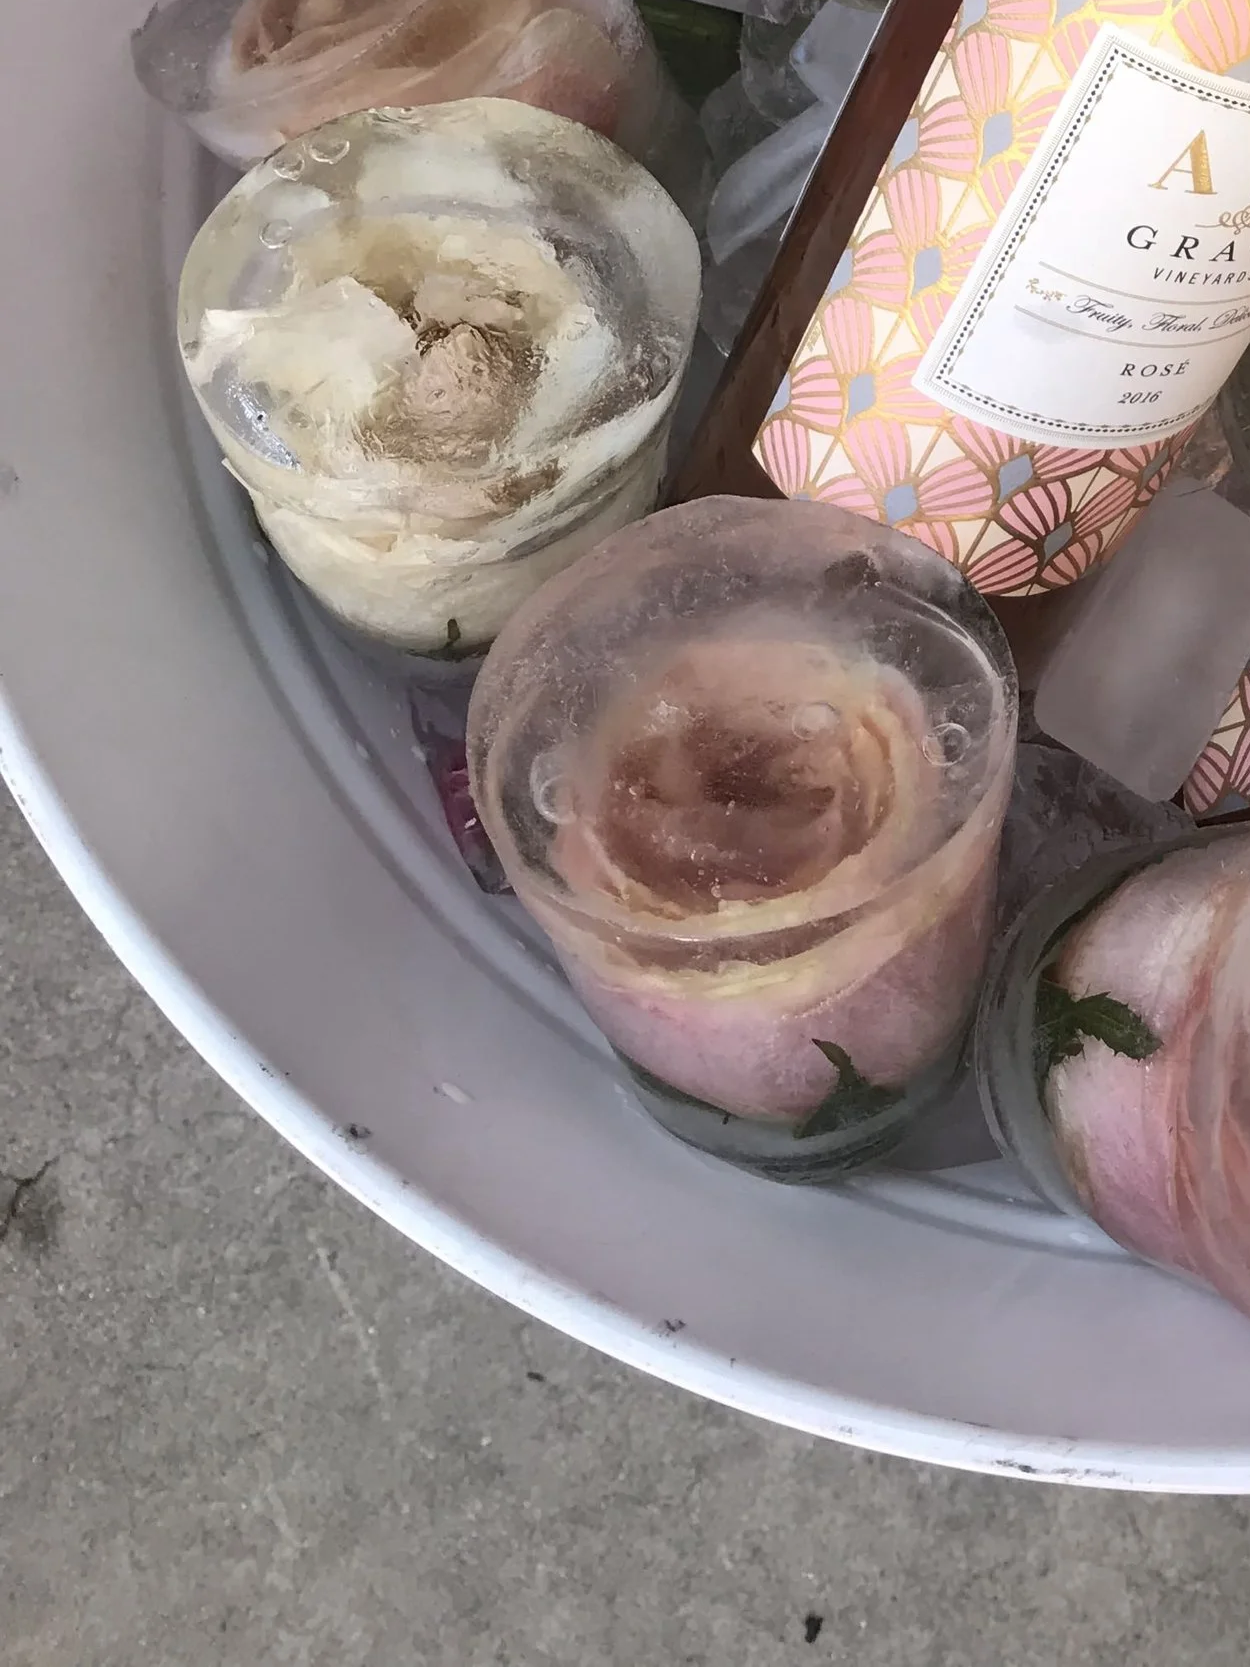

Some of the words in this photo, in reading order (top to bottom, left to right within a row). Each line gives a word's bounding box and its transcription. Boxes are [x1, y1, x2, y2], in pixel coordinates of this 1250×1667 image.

[1066, 295, 1133, 332] Fruity,
[1142, 311, 1208, 332] Floral,
[1119, 358, 1190, 377] ROSÉ
[1117, 390, 1162, 405] 2016
